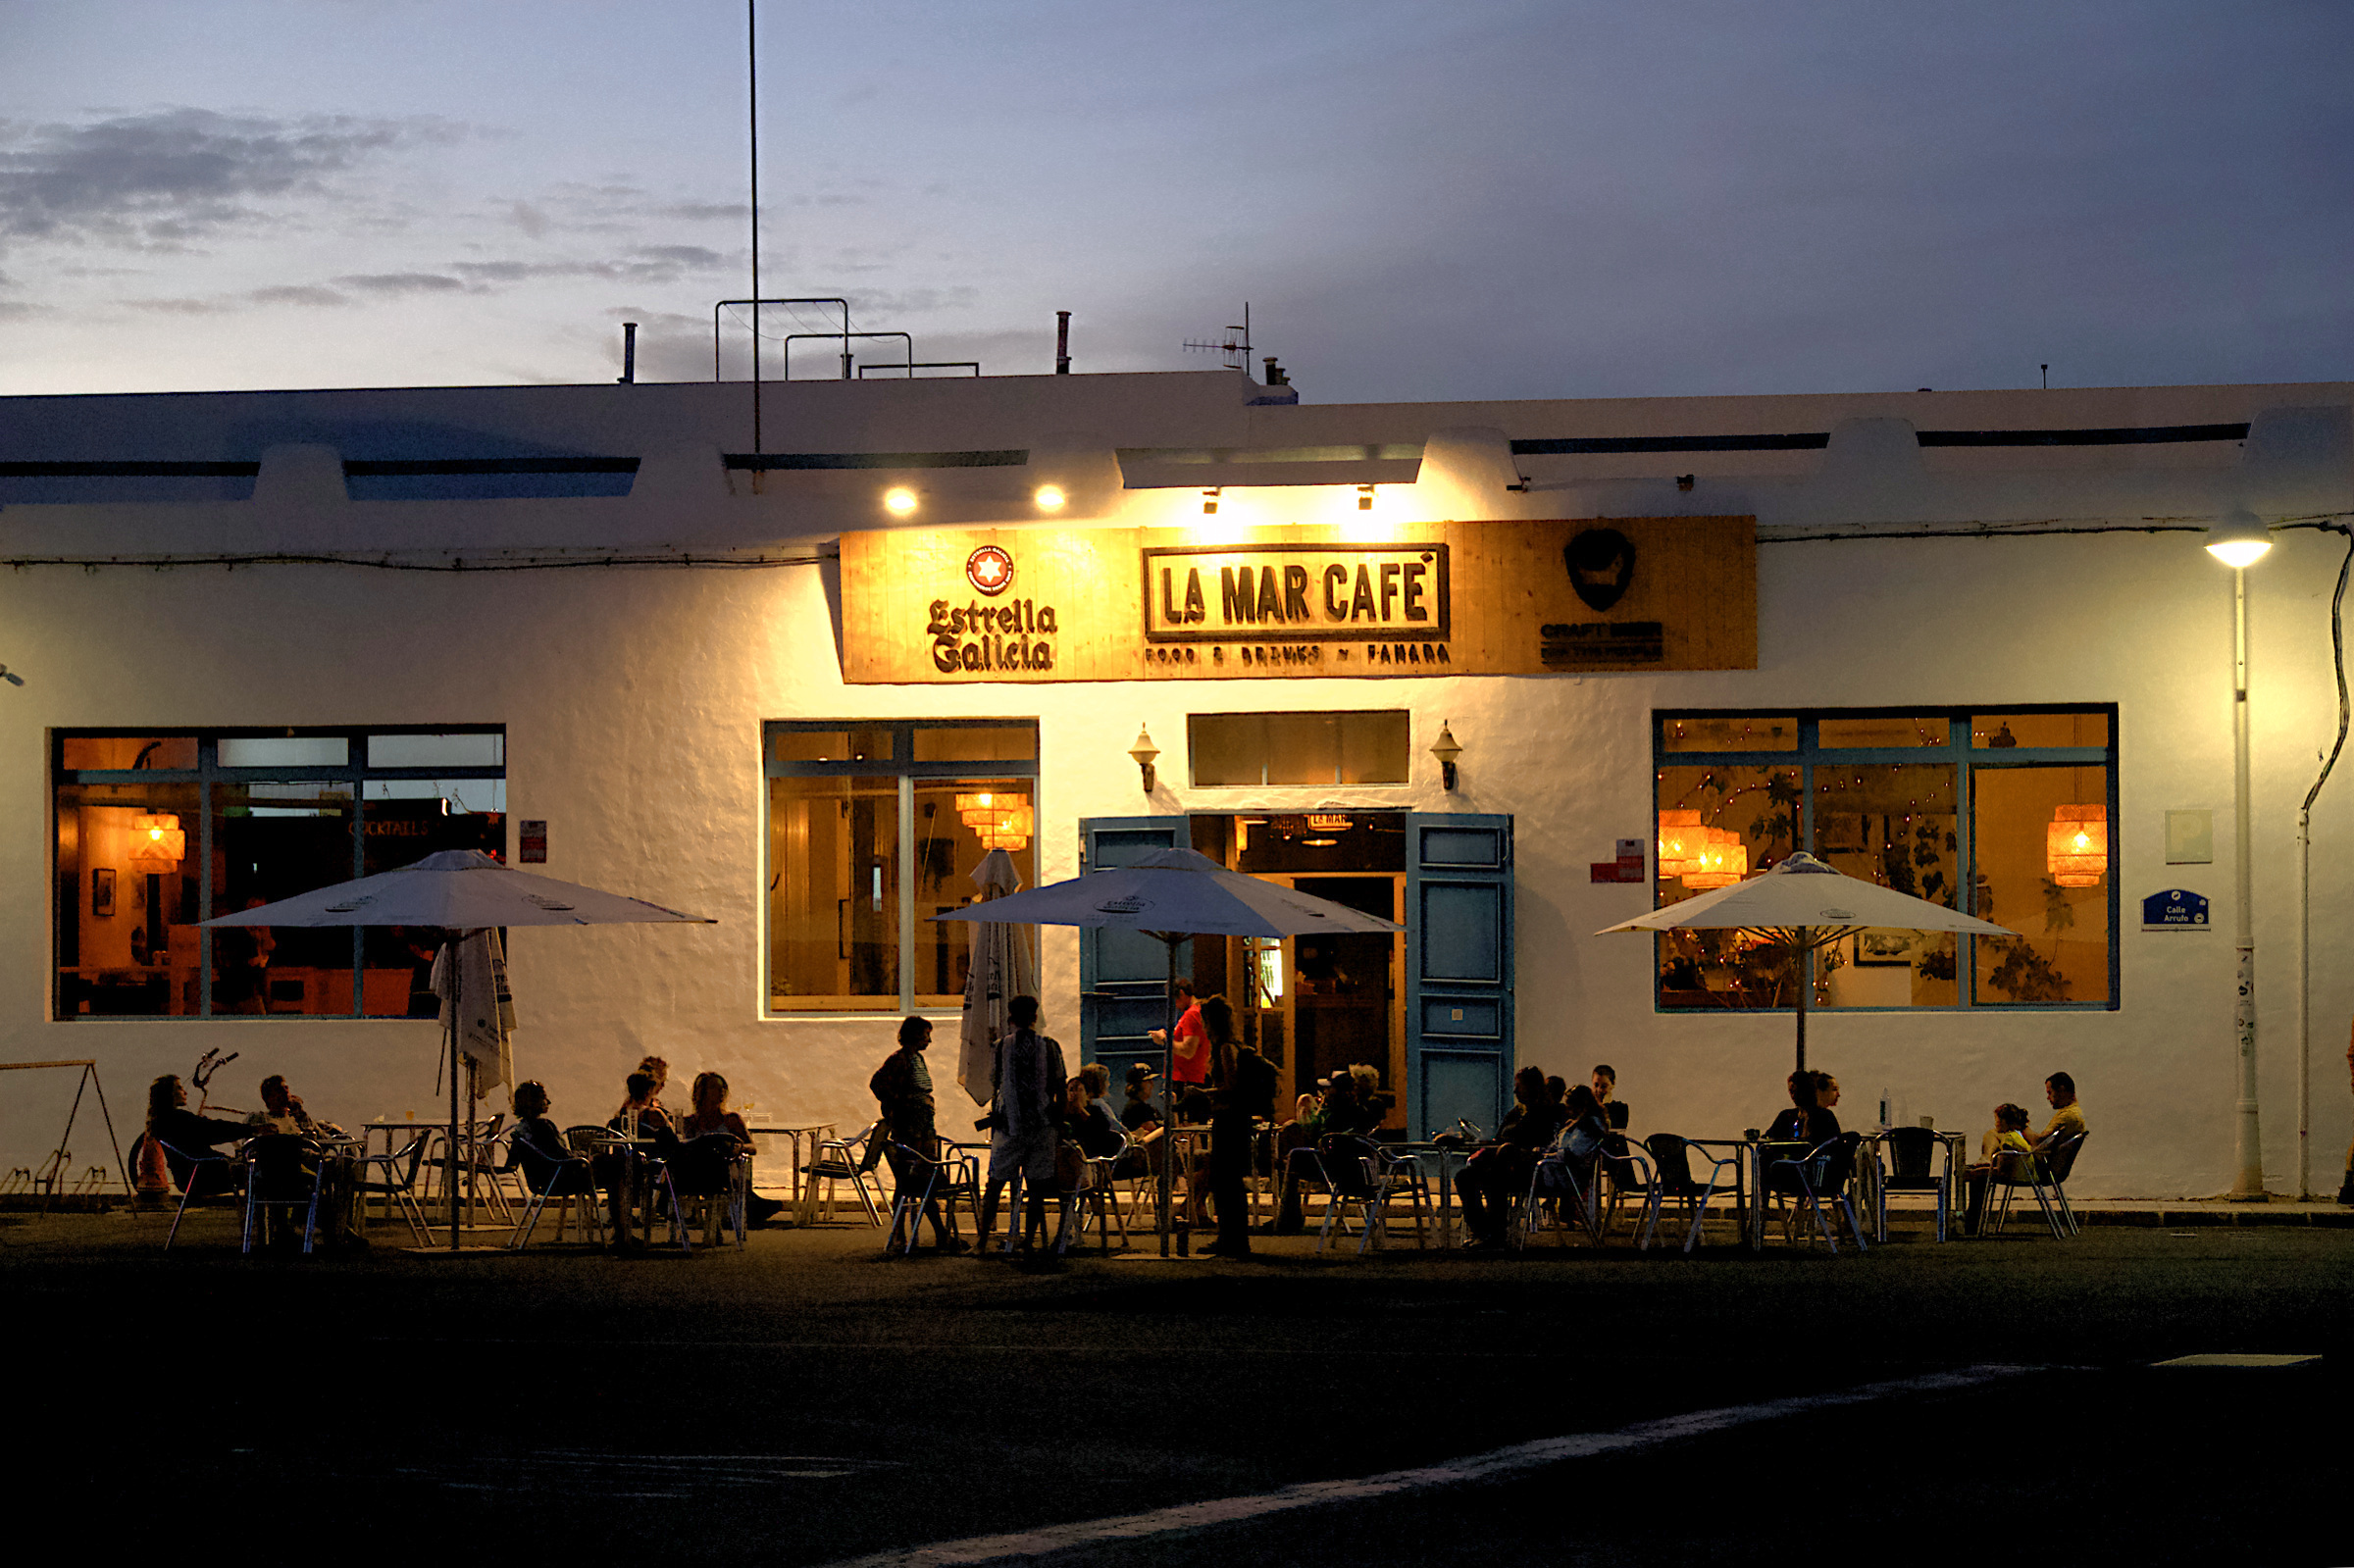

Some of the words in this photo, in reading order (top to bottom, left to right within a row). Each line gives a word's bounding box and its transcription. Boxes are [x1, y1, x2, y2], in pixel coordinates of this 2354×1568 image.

[1161, 567, 1205, 625] LA
[1221, 565, 1311, 625] MAR
[926, 598, 1058, 635] Estrella
[933, 633, 1053, 674] Galicia
[1145, 647, 1196, 667] FOOD
[1241, 644, 1321, 667] DRINKS
[1367, 642, 1452, 665] FAMARA
[2166, 905, 2186, 914] Calle
